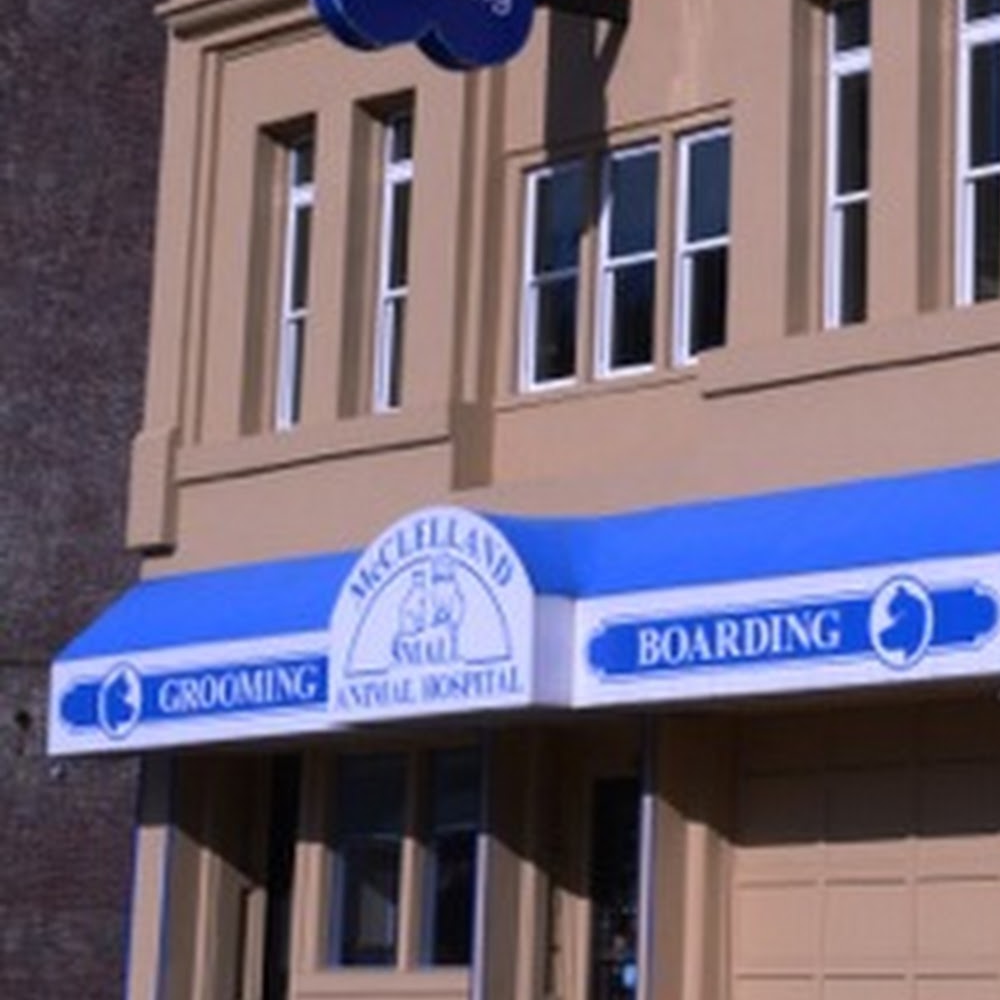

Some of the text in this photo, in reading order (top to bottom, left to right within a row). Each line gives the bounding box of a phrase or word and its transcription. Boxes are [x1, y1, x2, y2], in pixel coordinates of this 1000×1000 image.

[636, 609, 841, 667] BOARDING
[157, 662, 320, 714] GROOMING
[334, 666, 524, 710] ANIMAL HOSPITAL
